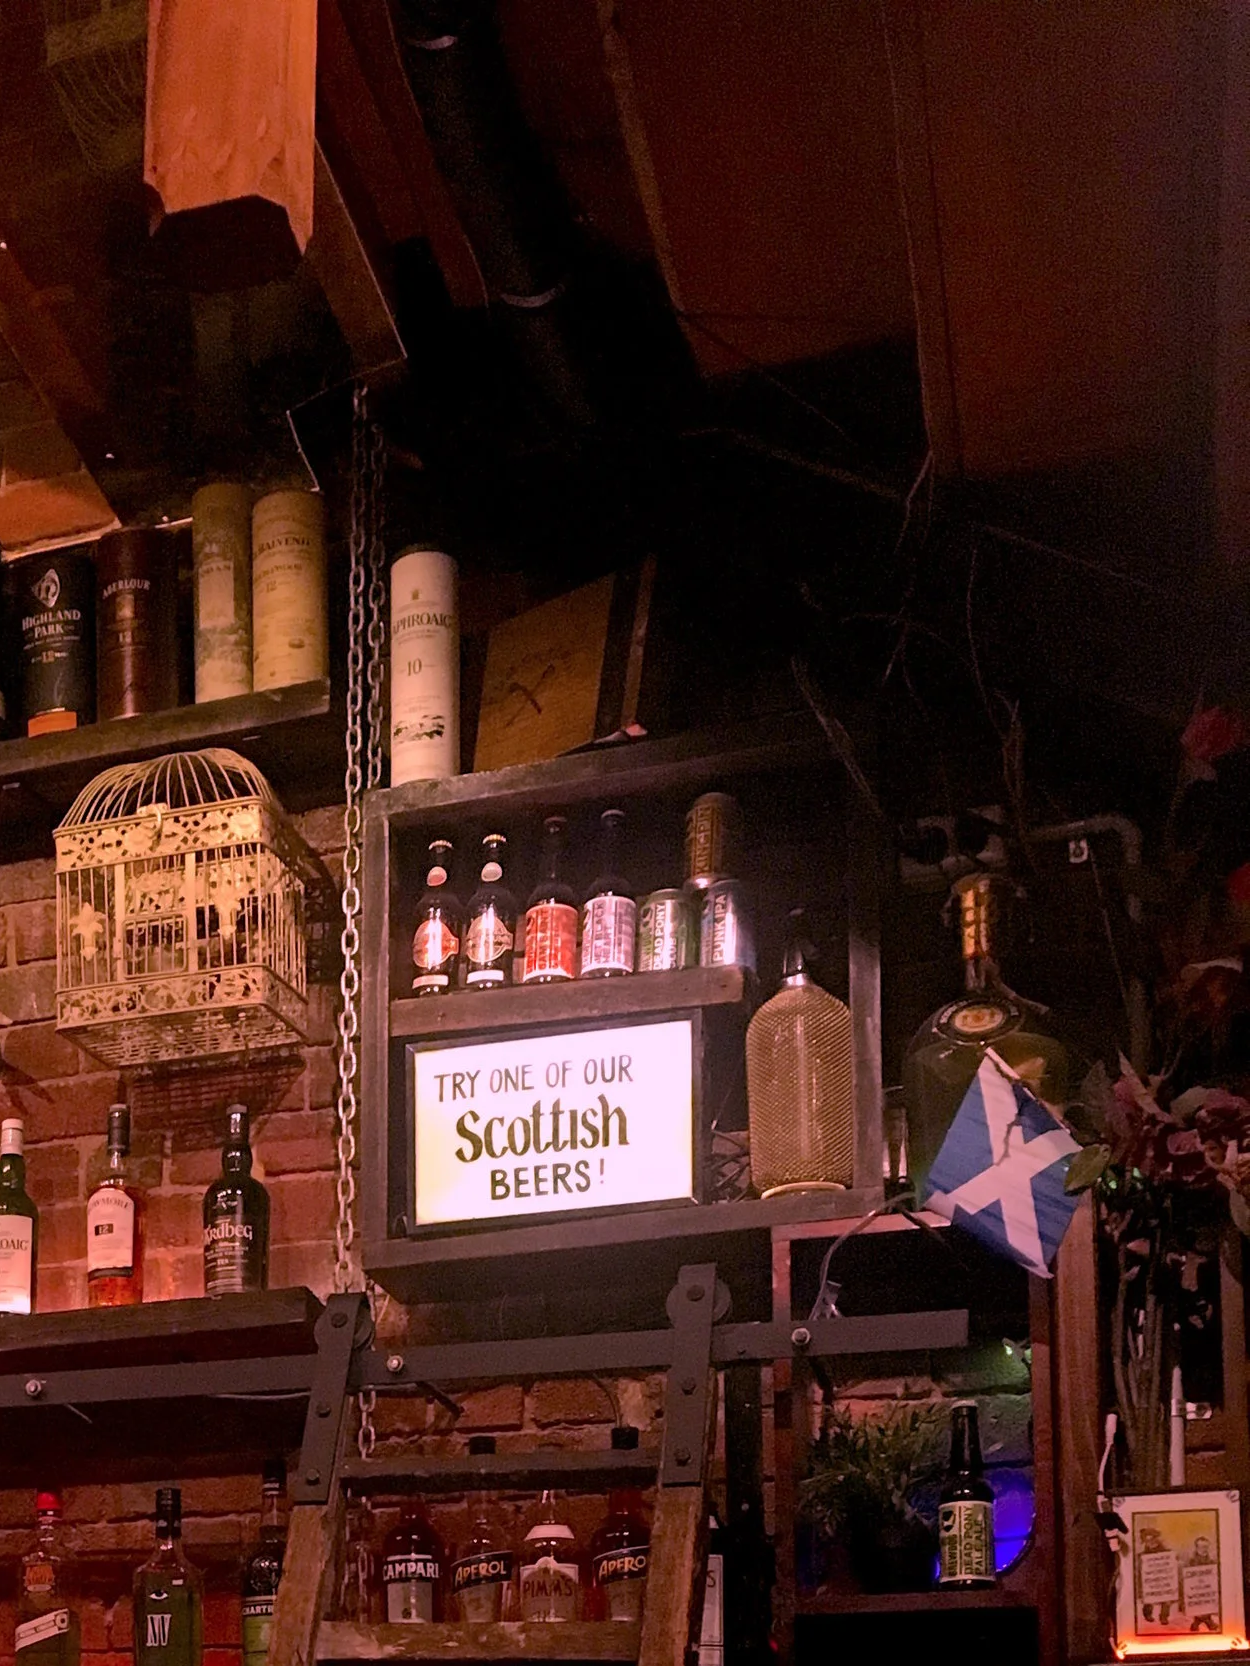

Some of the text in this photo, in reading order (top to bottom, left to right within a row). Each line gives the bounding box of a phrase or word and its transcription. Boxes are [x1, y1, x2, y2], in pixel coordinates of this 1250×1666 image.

[22, 610, 81, 631] HIGHLAND
[34, 623, 64, 639] PARK
[393, 613, 451, 635] APHROAIG
[407, 659, 422, 676] 10
[653, 904, 665, 969] DEAD PONY
[712, 893, 727, 962] PUNK IPA
[434, 1055, 633, 1102] TRY ONE OF OUR
[455, 1093, 629, 1163] Scottish
[491, 1158, 605, 1200] BEERS!
[204, 1221, 253, 1245] Ardbeg
[964, 1506, 973, 1575] DEAD PONY
[974, 1519, 983, 1575] PALE ALE
[383, 1561, 440, 1580] CAMPARI
[454, 1562, 507, 1587] APEROL
[599, 1556, 647, 1584] APERO
[523, 1578, 573, 1598] PIMM'S
